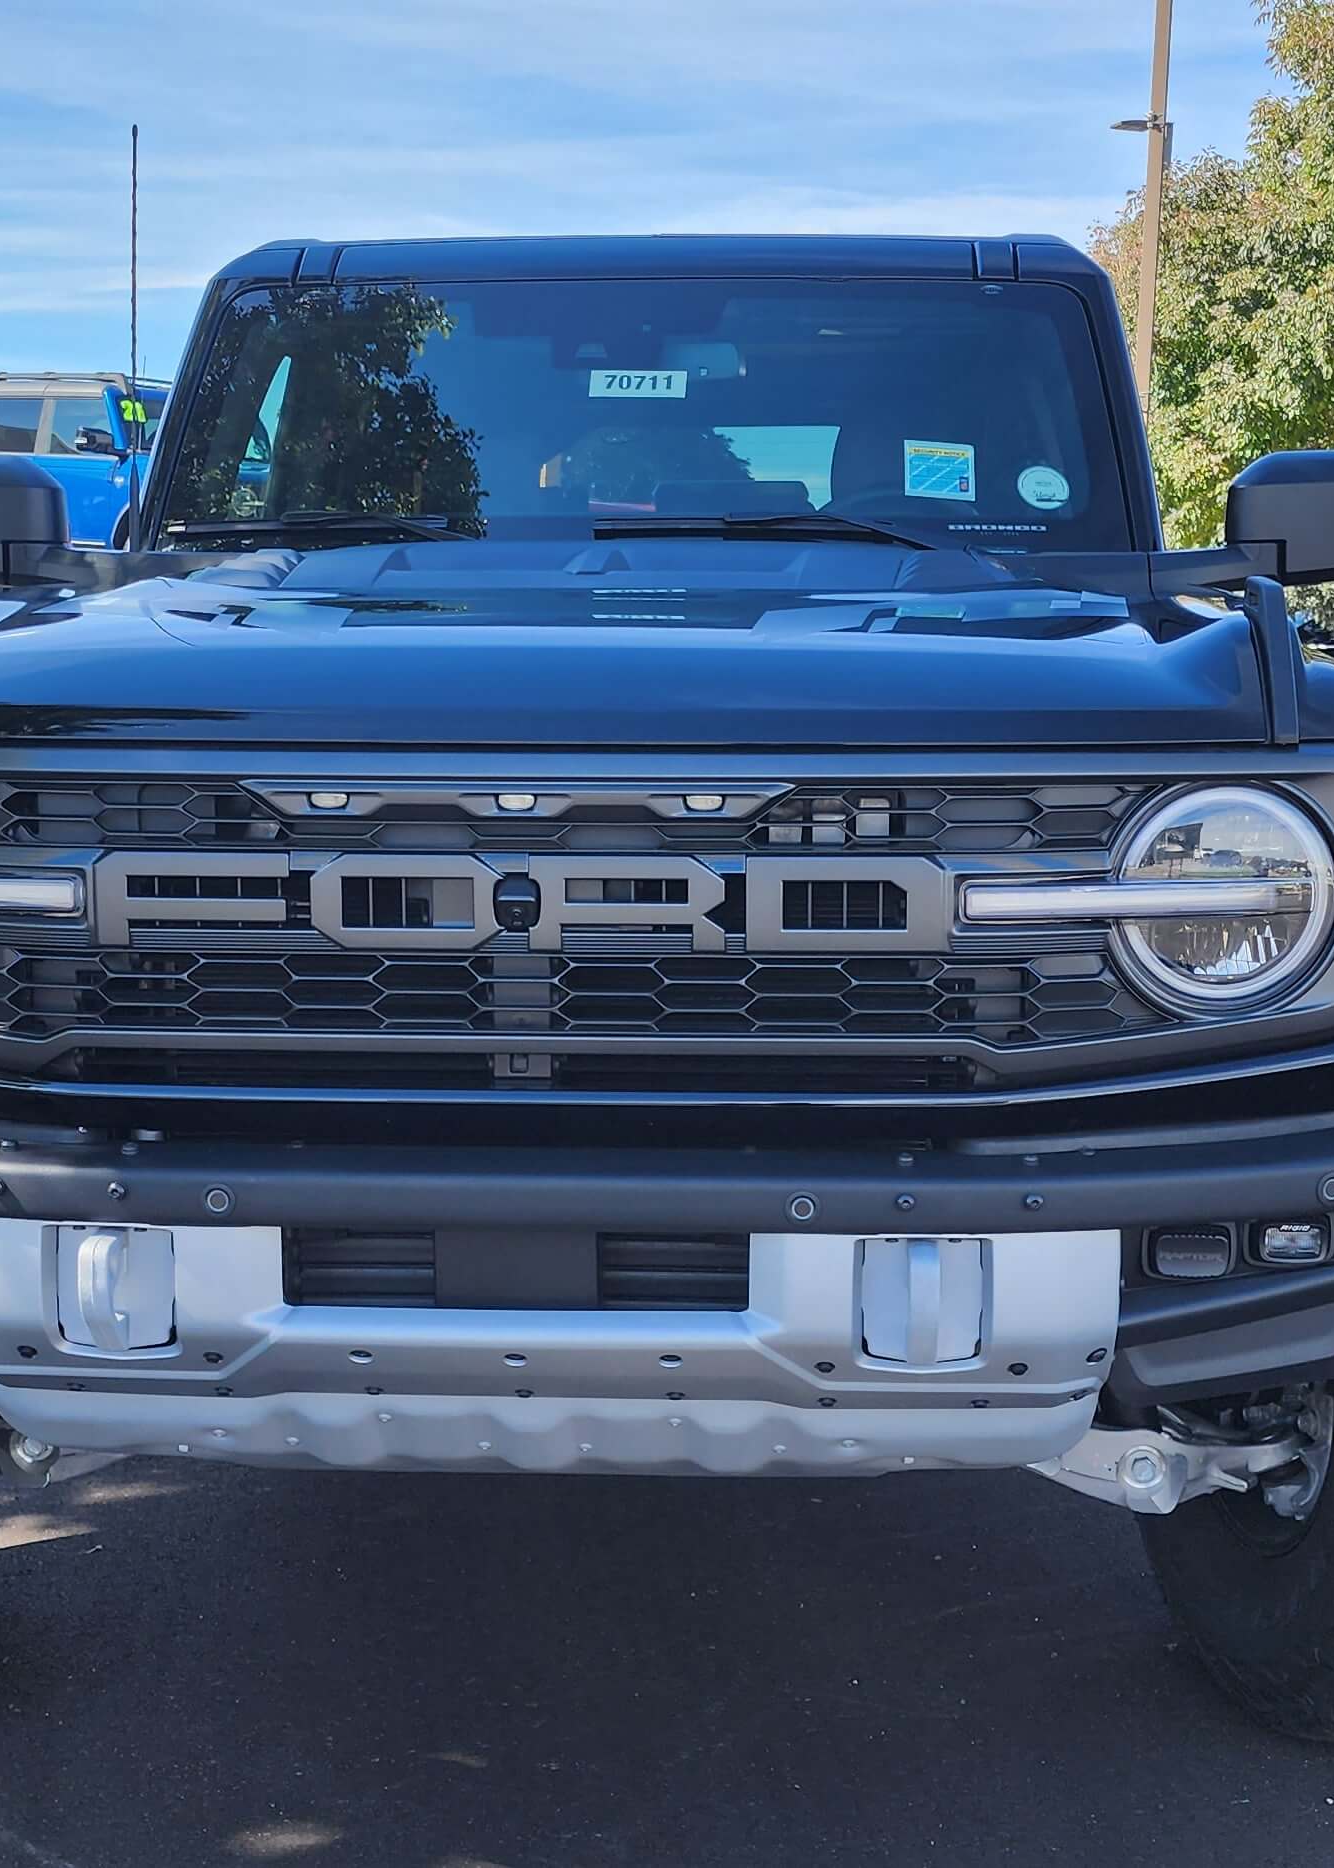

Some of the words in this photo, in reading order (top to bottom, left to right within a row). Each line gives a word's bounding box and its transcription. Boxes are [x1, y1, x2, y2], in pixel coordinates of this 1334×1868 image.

[604, 374, 673, 390] 70711
[948, 524, 1047, 532] BRONCO
[91, 851, 951, 954] FORD
[1158, 1250, 1224, 1263] RAPTOR
